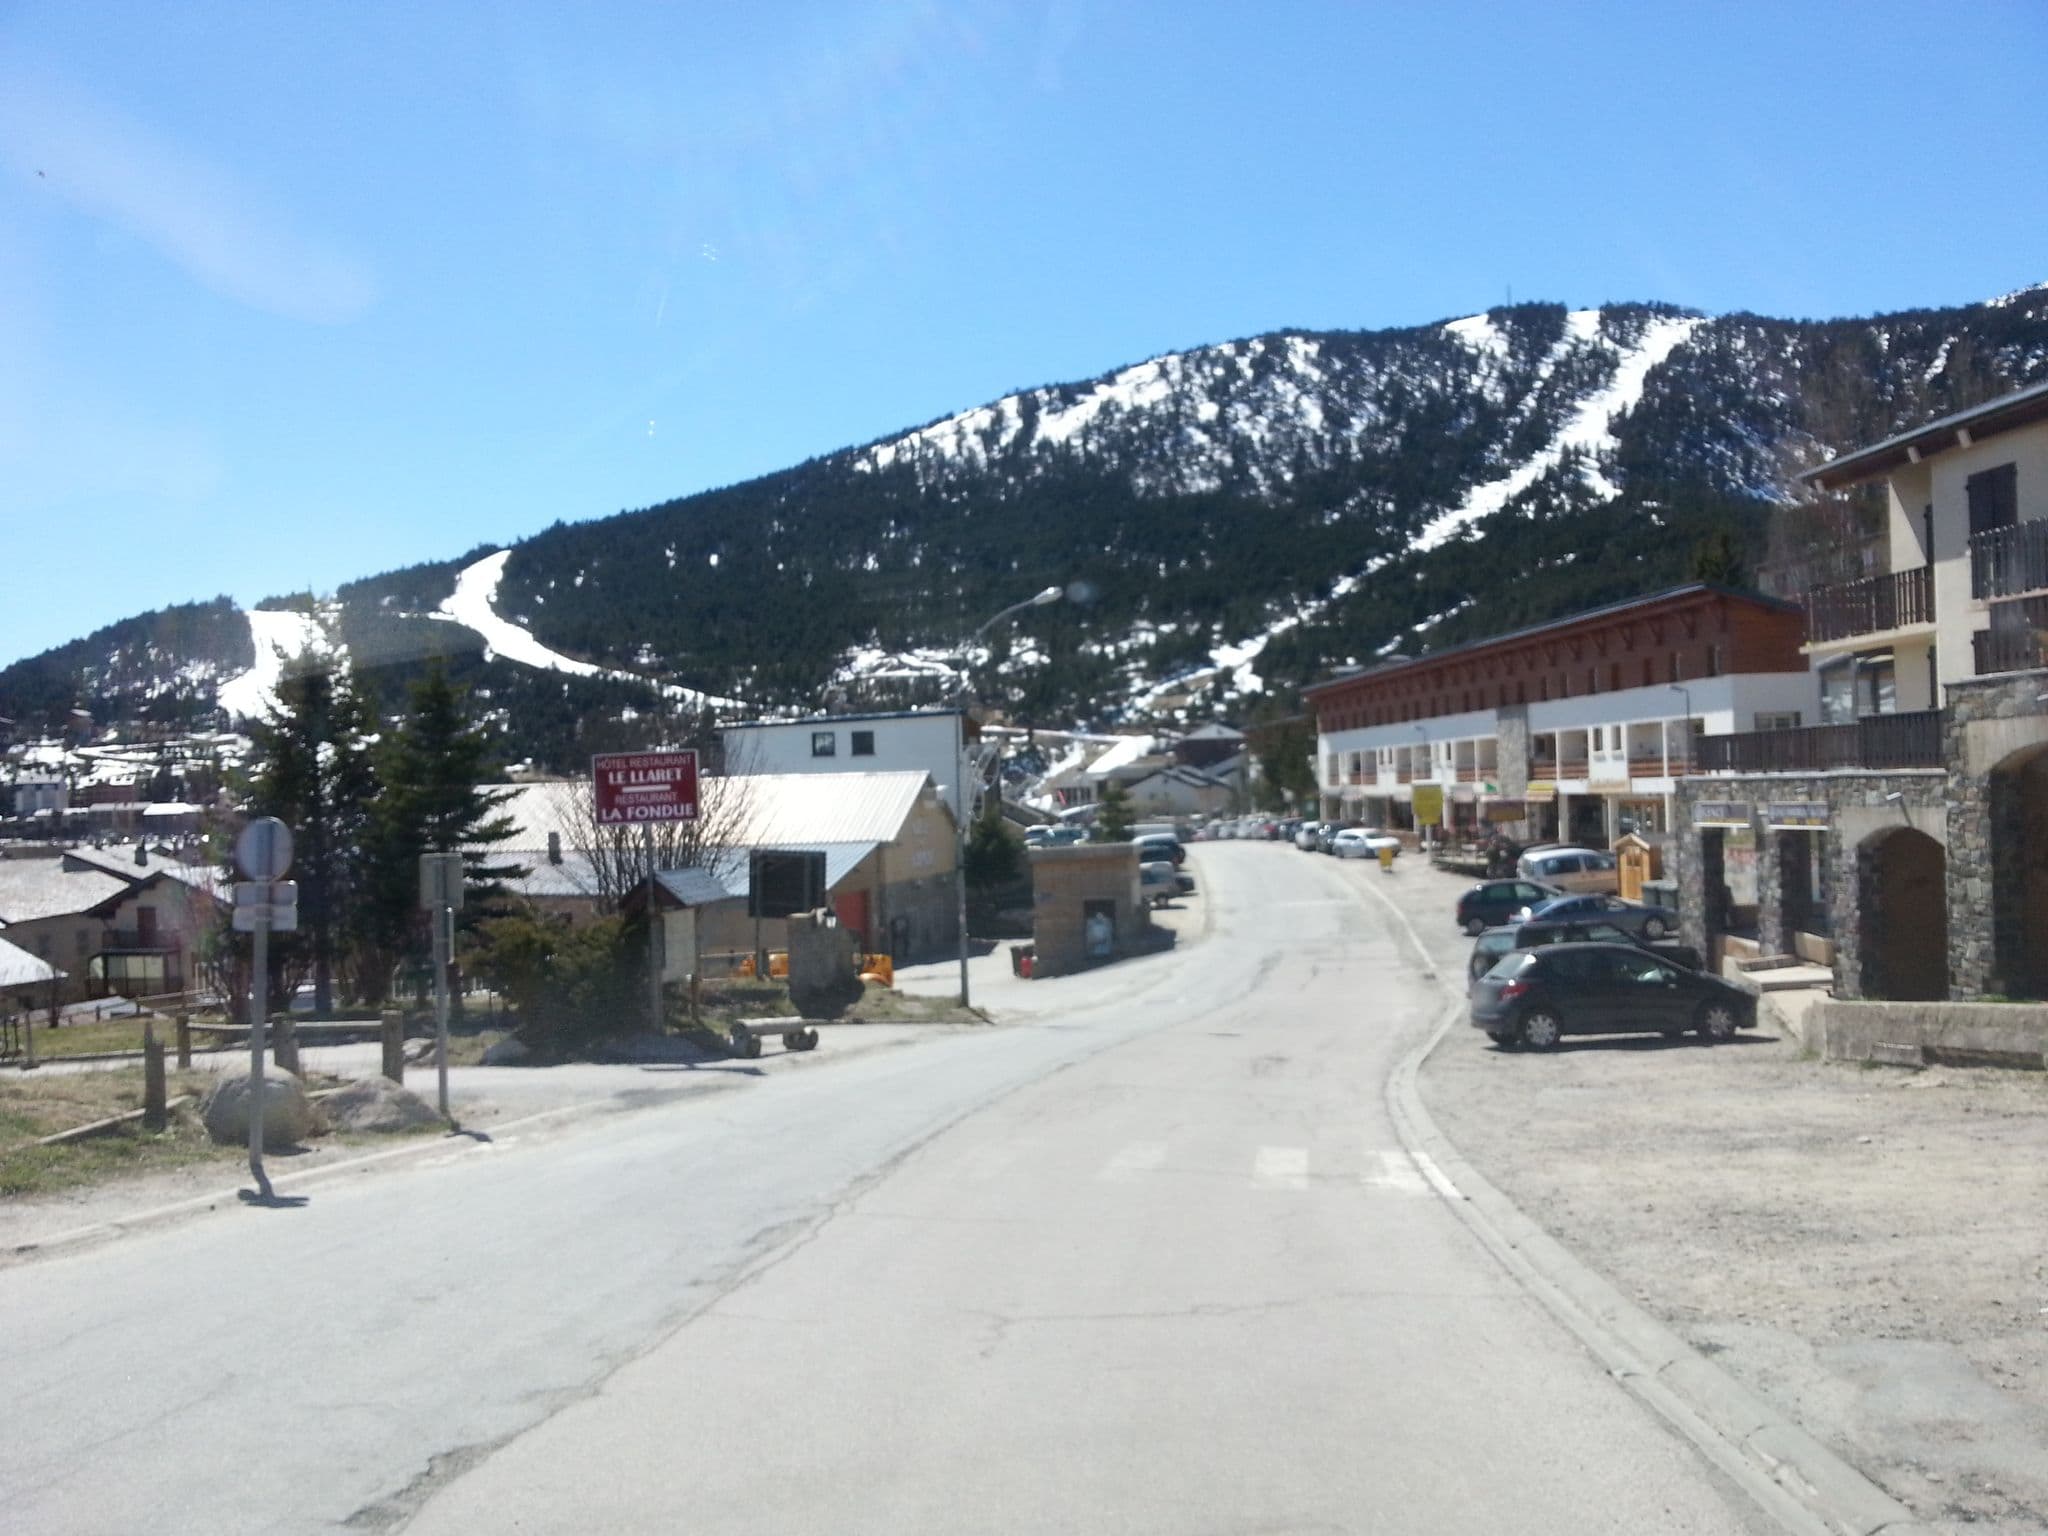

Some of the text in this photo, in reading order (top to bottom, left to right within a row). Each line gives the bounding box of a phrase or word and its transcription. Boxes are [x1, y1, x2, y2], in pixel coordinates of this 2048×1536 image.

[630, 755, 691, 768] RESTAURANT
[608, 767, 682, 784] LE LLARET
[615, 792, 678, 804] RESTAURANT
[602, 803, 694, 820] LA FONDUE
